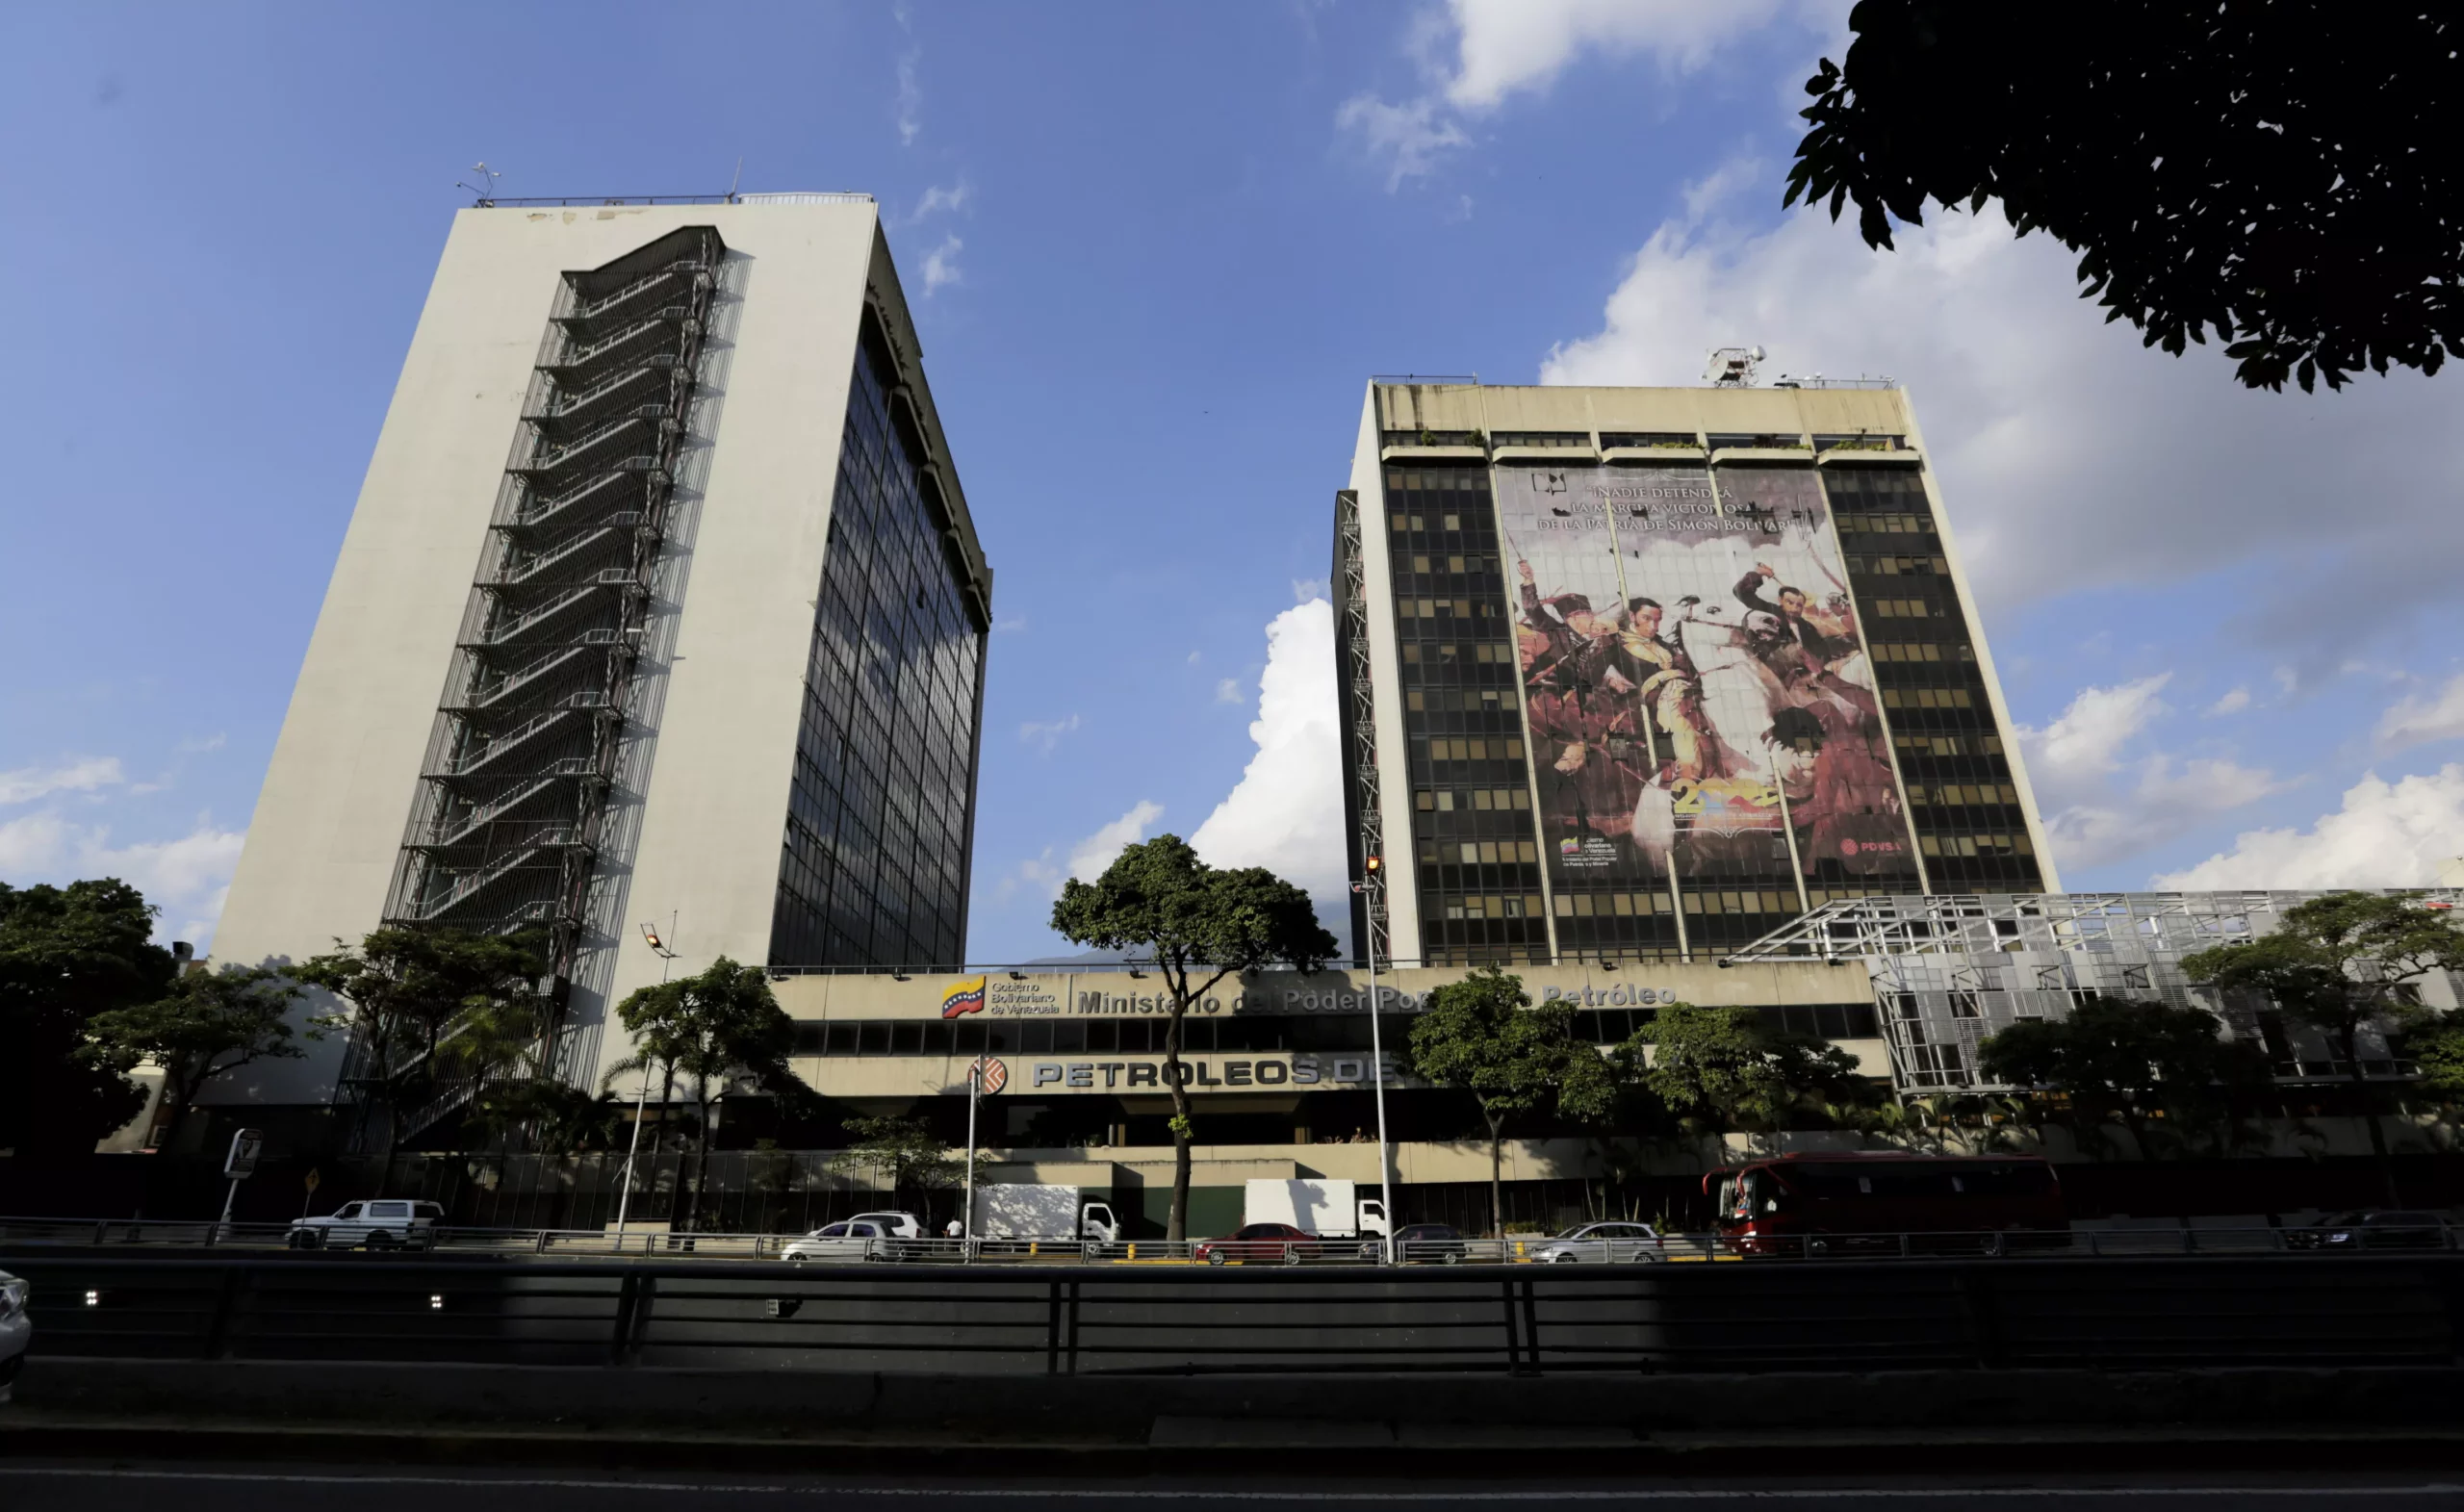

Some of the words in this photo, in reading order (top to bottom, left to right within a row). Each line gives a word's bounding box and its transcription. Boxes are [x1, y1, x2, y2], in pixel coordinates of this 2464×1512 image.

[1539, 520, 1558, 530] DE
[1564, 520, 1582, 530] LA
[1644, 521, 1664, 530] DE
[1668, 518, 1719, 530] SIMÓN
[1861, 841, 1903, 852] PDVSA
[991, 982, 1040, 992] Gobierno
[991, 993, 1056, 1004] Bolivariano
[1283, 988, 1367, 1012] Poder
[991, 1004, 1005, 1015] de
[1006, 1004, 1060, 1015] Venezuela
[1033, 1059, 1321, 1088] PETROLEOS
[1334, 1060, 1396, 1083] DE
